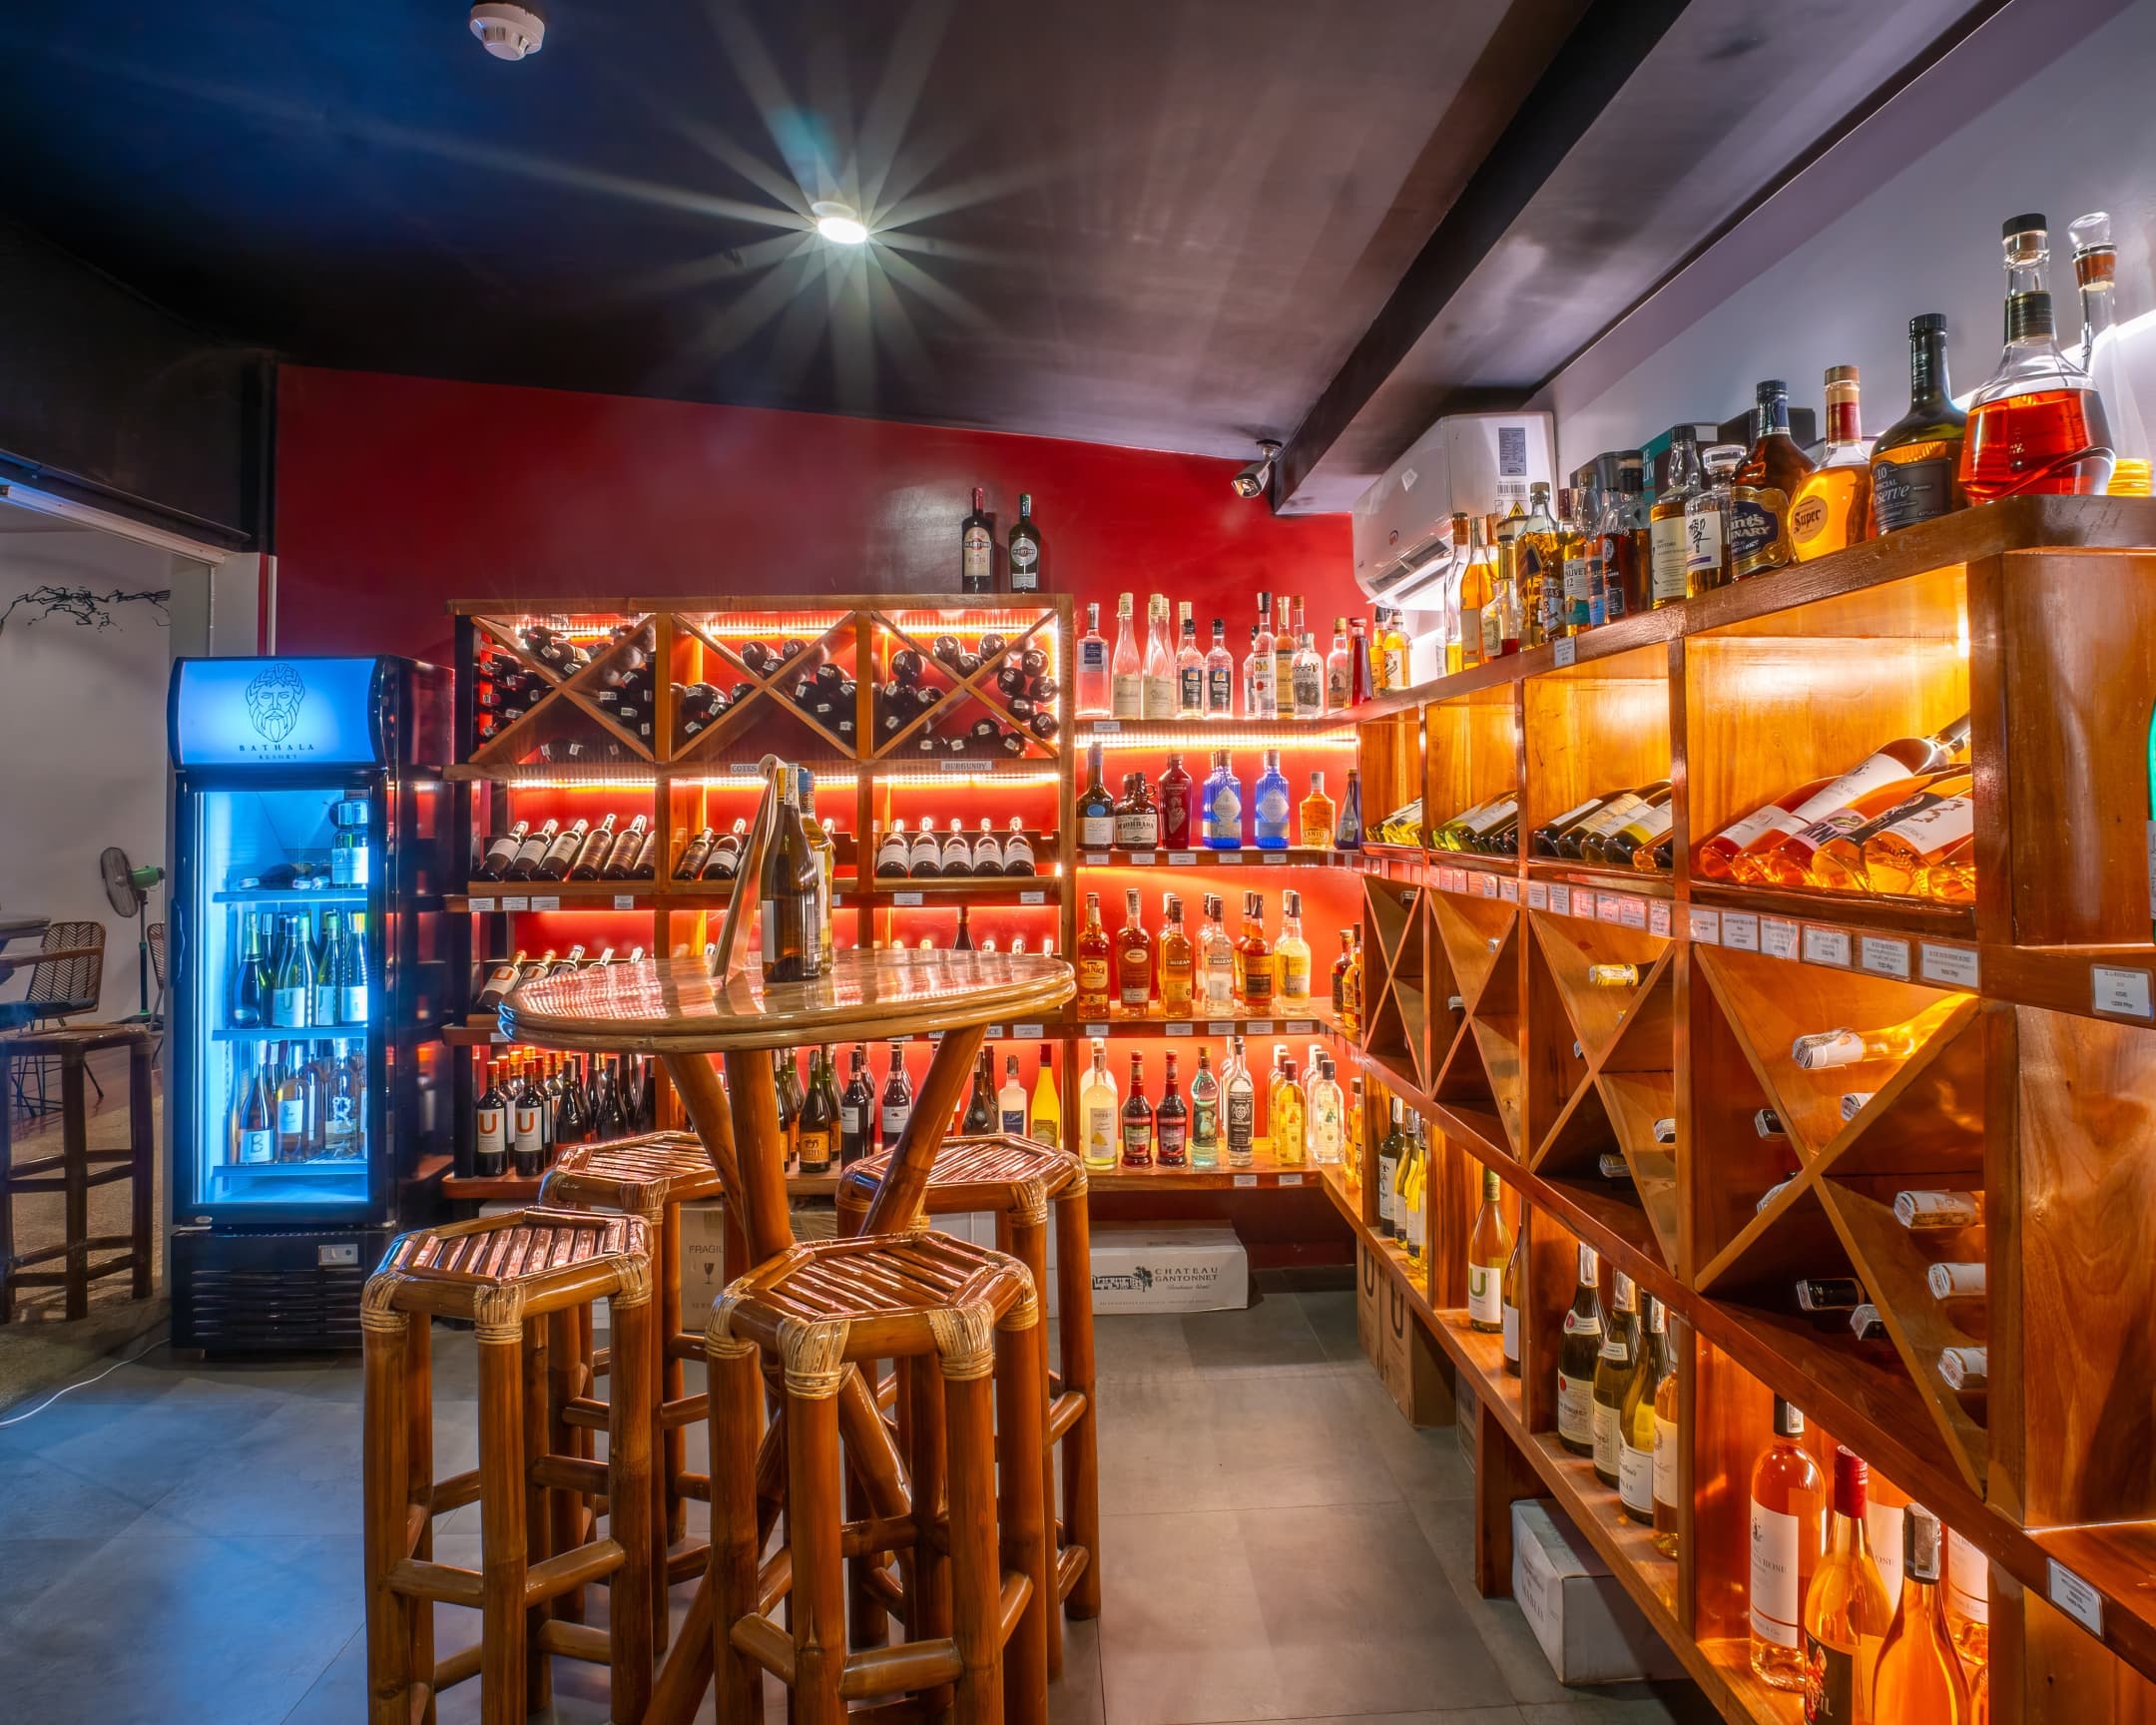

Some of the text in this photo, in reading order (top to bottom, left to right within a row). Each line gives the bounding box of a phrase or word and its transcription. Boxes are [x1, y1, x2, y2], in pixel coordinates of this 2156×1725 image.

[1794, 509, 1821, 534] Super
[239, 743, 314, 752] BATHALA
[479, 1112, 497, 1134] U
[517, 1111, 535, 1134] U
[689, 1245, 724, 1254] FRAGIL
[1469, 1268, 1486, 1297] U
